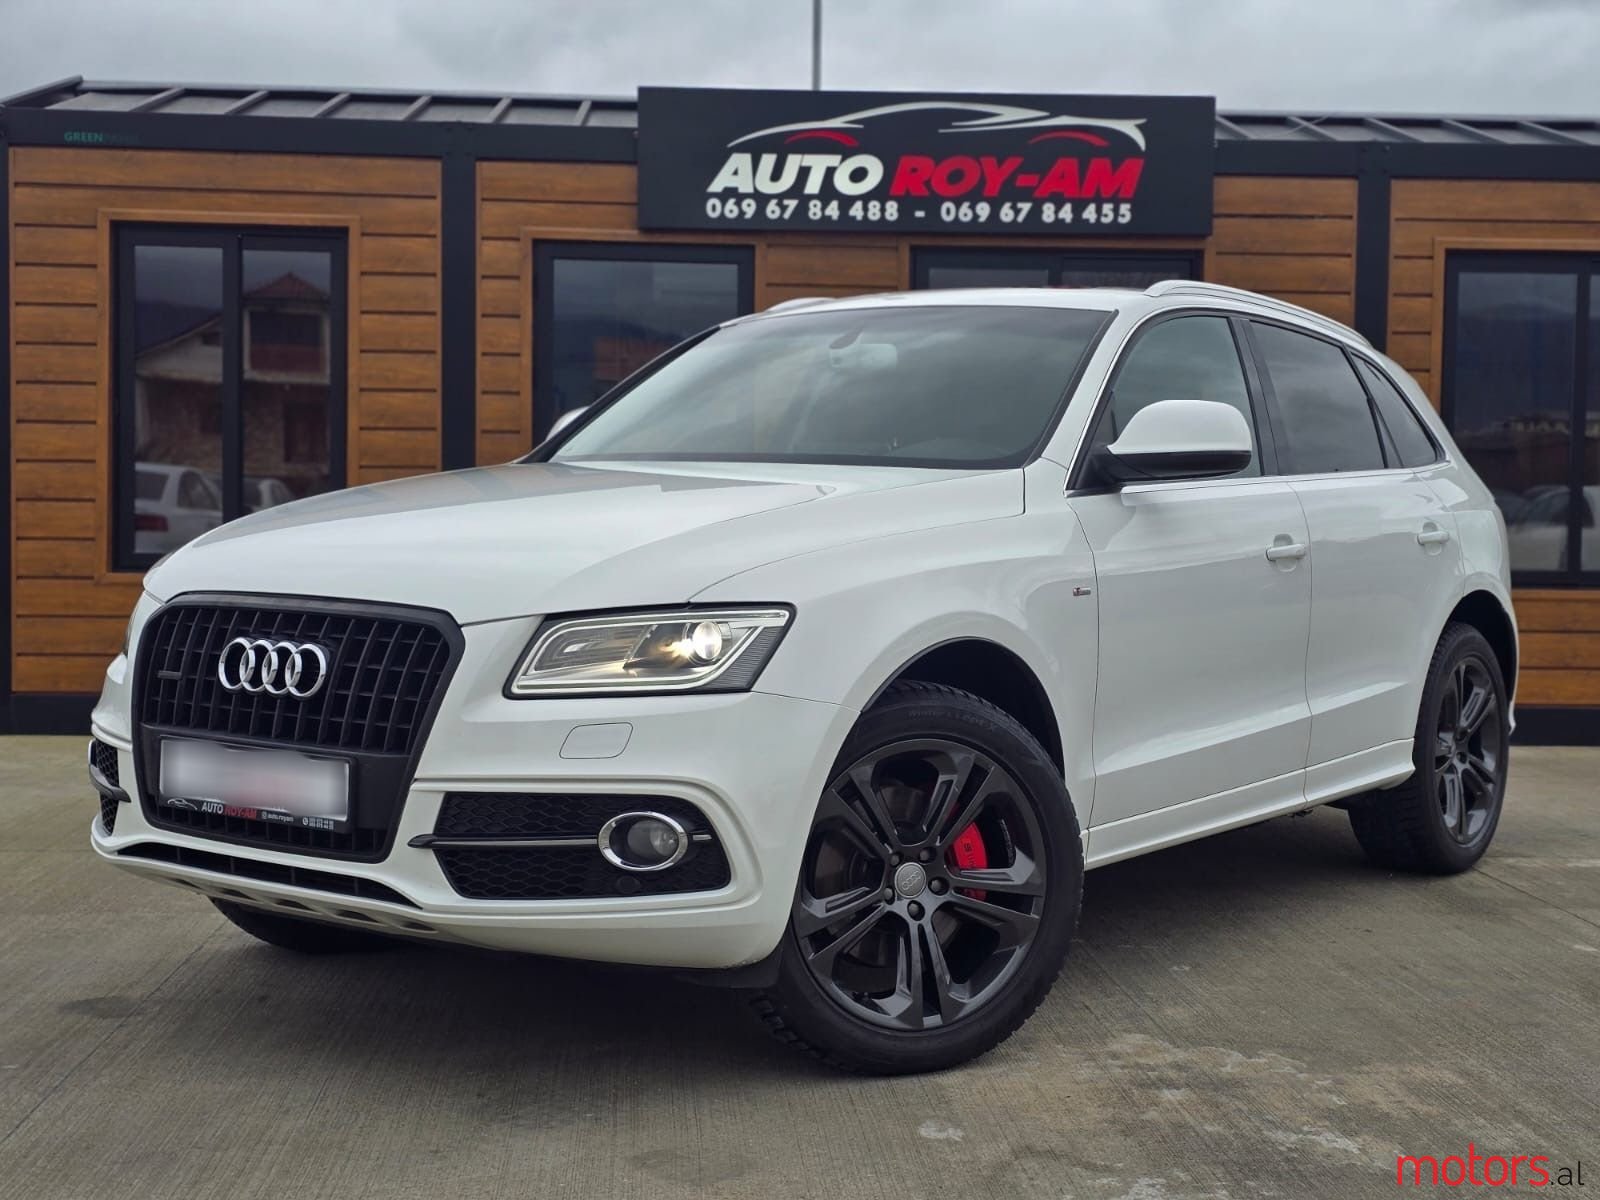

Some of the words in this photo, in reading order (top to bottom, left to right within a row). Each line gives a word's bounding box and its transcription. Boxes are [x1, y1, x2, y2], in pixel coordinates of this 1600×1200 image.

[63, 131, 103, 143] GREEN
[706, 153, 885, 196] AUTO
[889, 155, 1145, 199] ROY-AM
[705, 198, 757, 219] 069
[765, 199, 799, 220] 67
[807, 200, 840, 221] 84
[848, 200, 899, 222] 488
[940, 201, 991, 223] 069
[999, 202, 1033, 224] 67
[1041, 202, 1073, 224] 84
[1081, 203, 1132, 224] 455
[201, 802, 224, 815] AUTO
[225, 806, 257, 820] ROY-AM
